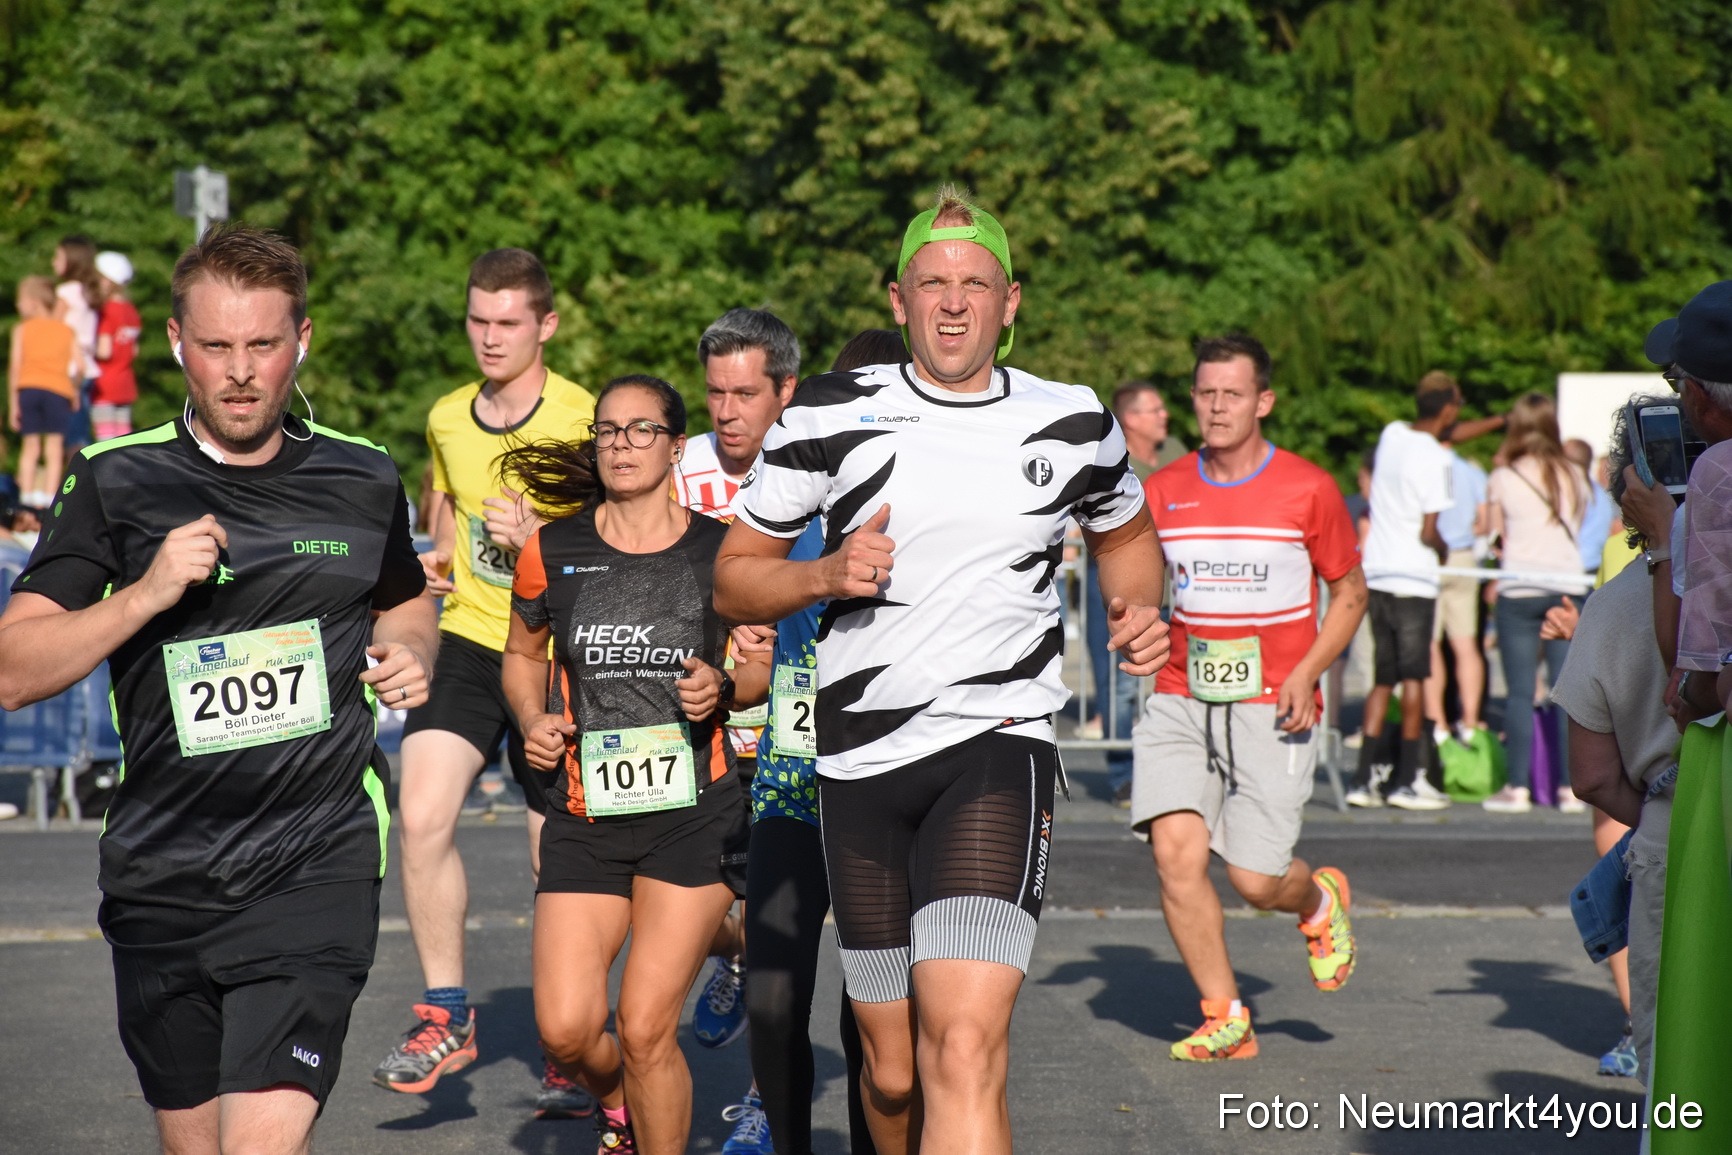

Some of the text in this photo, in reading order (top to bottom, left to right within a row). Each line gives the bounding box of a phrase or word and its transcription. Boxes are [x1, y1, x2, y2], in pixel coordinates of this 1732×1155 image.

[293, 540, 349, 556] DIETER
[1193, 561, 1268, 582] Petry
[574, 625, 655, 644] HECK
[190, 654, 250, 674] firmenlauf
[287, 651, 314, 664] 2019
[585, 647, 694, 665] DESIGN
[636, 669, 685, 680] Werbung!
[1193, 660, 1249, 683] 1829
[189, 664, 305, 723] 2097
[196, 733, 229, 745] Sarango
[277, 720, 299, 730] Dieter
[300, 715, 315, 725] Böll
[224, 712, 286, 730] Böll Dieter
[595, 744, 639, 756] firmenlauf
[665, 746, 685, 754] 2019
[596, 755, 678, 791] 1017
[614, 788, 665, 799] Richter Ulla
[627, 798, 649, 806] Design
[291, 1045, 320, 1068] JAKO
